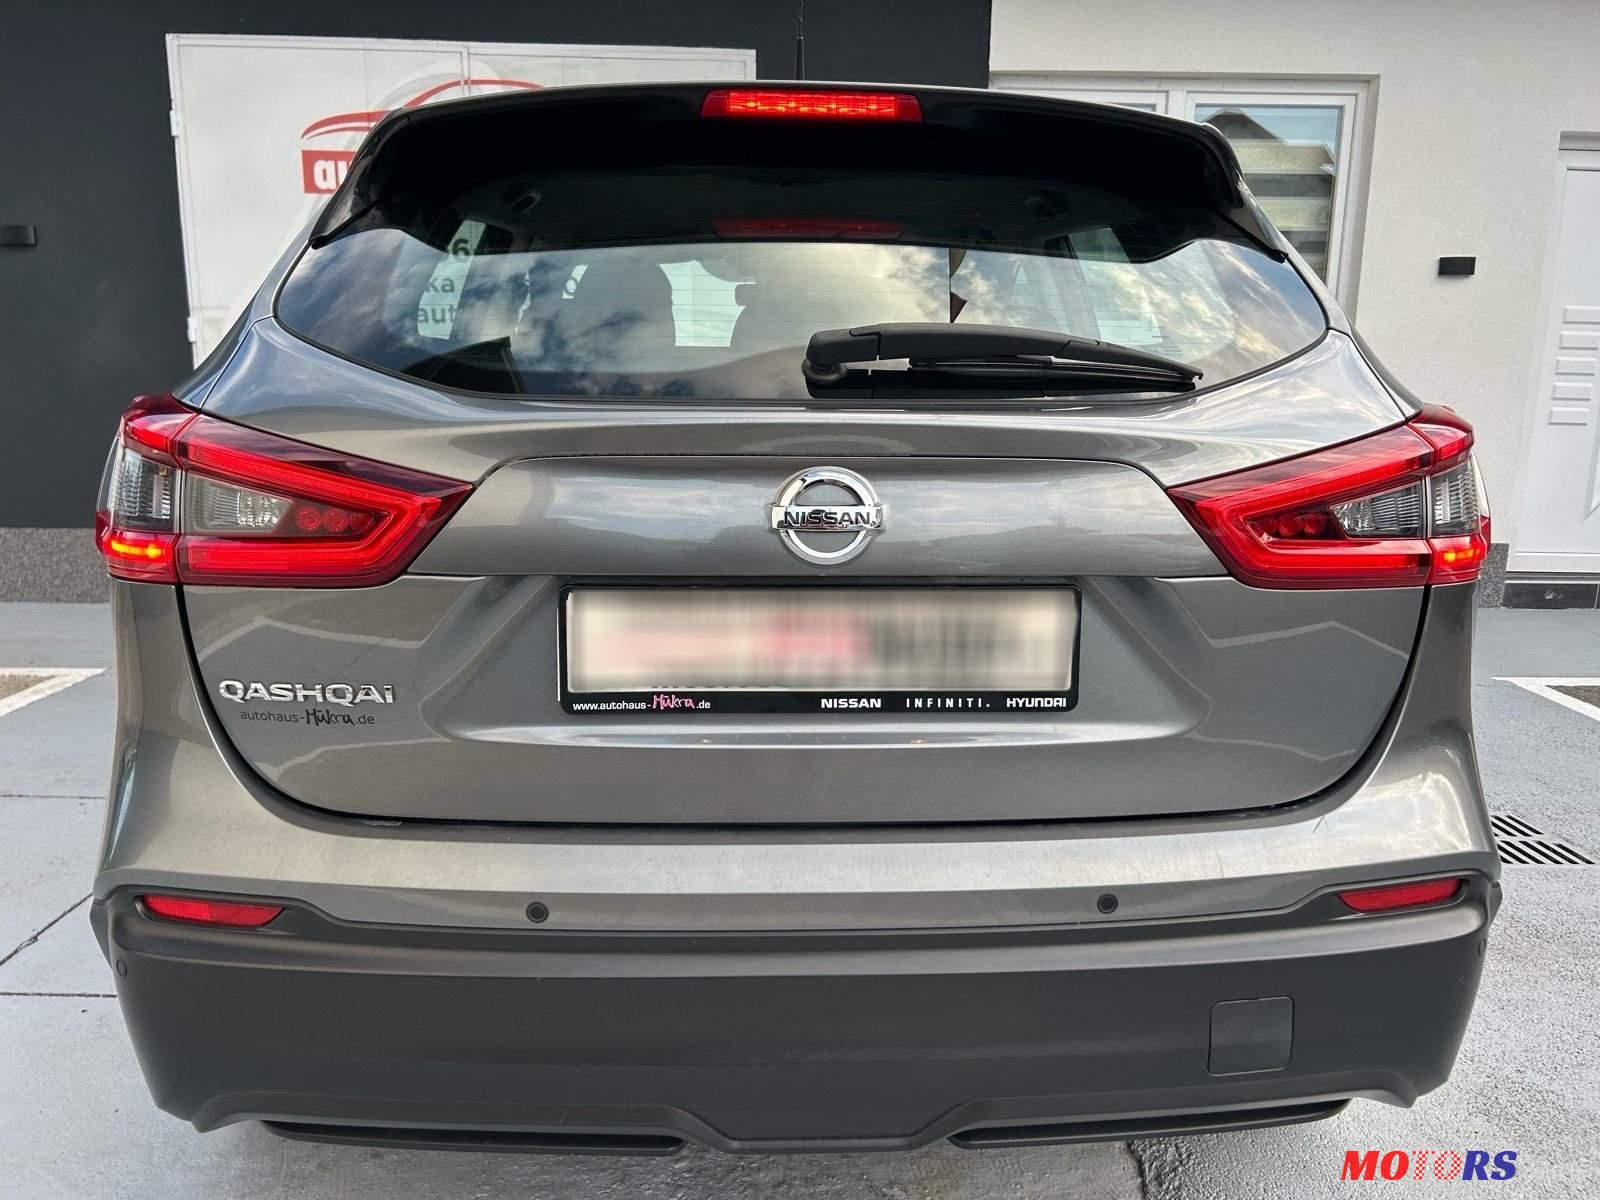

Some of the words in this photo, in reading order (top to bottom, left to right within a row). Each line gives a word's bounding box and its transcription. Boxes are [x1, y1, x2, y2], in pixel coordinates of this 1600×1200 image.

[783, 510, 871, 526] NISSAN
[219, 680, 395, 707] QASHQAI
[820, 698, 882, 709] NISSAN
[1006, 697, 1067, 708] HYUNDAI
